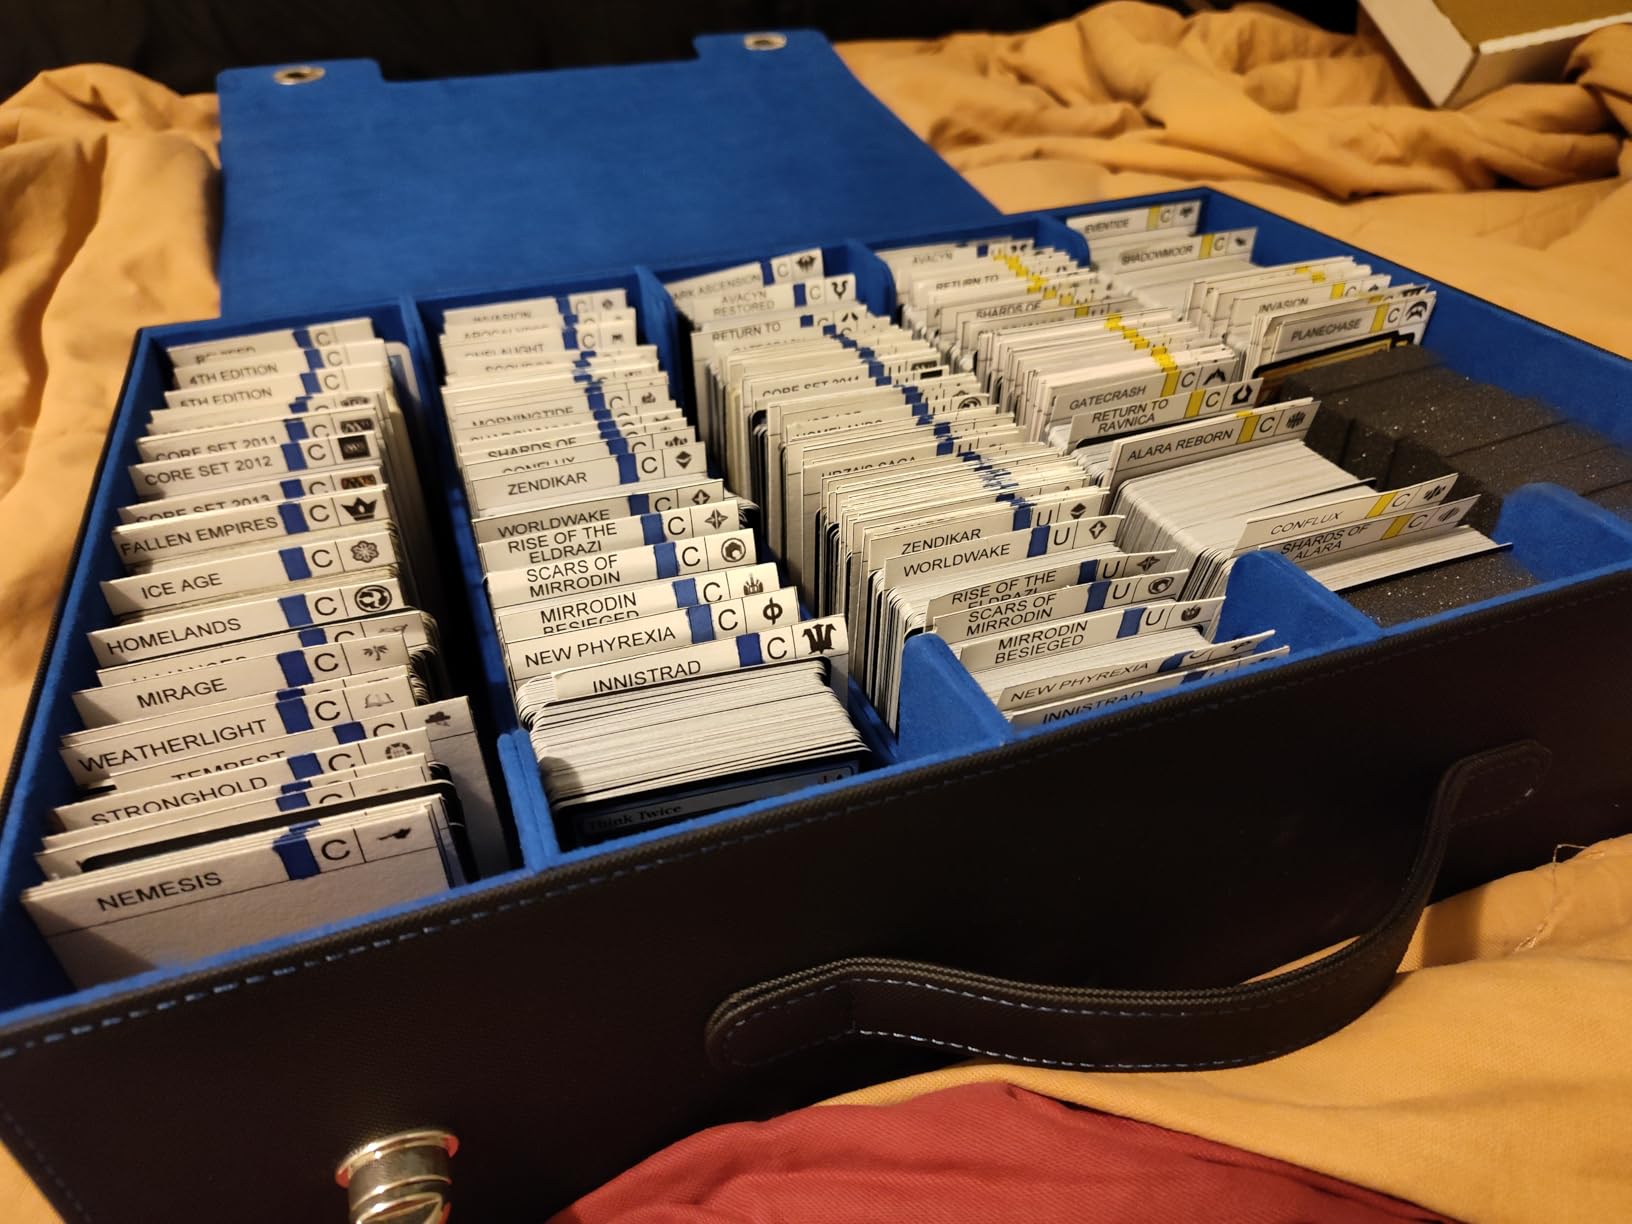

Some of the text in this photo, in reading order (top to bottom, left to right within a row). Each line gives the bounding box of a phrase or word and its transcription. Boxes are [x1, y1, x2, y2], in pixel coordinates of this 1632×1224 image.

[1159, 209, 1171, 224] C
[1213, 237, 1226, 251] C
[776, 263, 790, 278] C
[713, 300, 775, 317] RESTORED
[808, 285, 822, 300] C
[1258, 297, 1310, 314] INVASION
[582, 333, 596, 349] C
[764, 321, 781, 334] TO
[1290, 307, 1400, 343] PLANECHASE C
[189, 350, 343, 387] 4TH EDITION C
[211, 387, 273, 404] EDITION
[324, 373, 341, 391] C
[1069, 372, 1196, 411] GATECRASH C
[1092, 391, 1221, 424] RETURN TO C
[311, 423, 329, 440] C
[1098, 412, 1156, 434] RAVNICA
[1127, 416, 1275, 462] ALARA REBORN C
[145, 443, 328, 487] CORE SET 2012 C
[507, 455, 659, 497] ZENDIKAR C
[120, 504, 331, 557] FALLEN EMPIRES C
[497, 496, 674, 539] WORLDWAKE C
[901, 509, 1053, 555] ZENDIKAR U
[1270, 493, 1411, 536] CONFLUX C
[508, 515, 687, 554] RISE OF THE C
[529, 540, 603, 565] ELDRAZI
[903, 527, 1071, 577] WORLDWAKE U
[1280, 514, 1429, 555] SHARDS OF C
[1293, 540, 1343, 561] ALARA
[141, 549, 334, 601] ICE AGE C
[527, 546, 702, 584] SCARS OF C
[529, 570, 621, 599] MIRRODIN
[951, 560, 1121, 606] RISE OF THE U
[540, 581, 723, 624] MIRRODIN C
[966, 606, 1054, 637] MIRRODIN
[968, 582, 1133, 623] SCARS OF U
[106, 595, 339, 656] HOMELANDS C
[525, 608, 740, 668] NEW PHYREXIA C
[998, 608, 1166, 651] MIRRODIN U
[593, 636, 789, 694] INNISTRAD C
[994, 634, 1085, 665] BESIEGED
[137, 652, 340, 709] MIRAGE C
[1010, 682, 1056, 703] NEW
[1058, 662, 1150, 691] PHYREXIA
[78, 700, 341, 773] WEATHERLIGHT C
[328, 752, 358, 773] C
[639, 804, 684, 821] Twice
[96, 838, 352, 913] NEMESIS C
